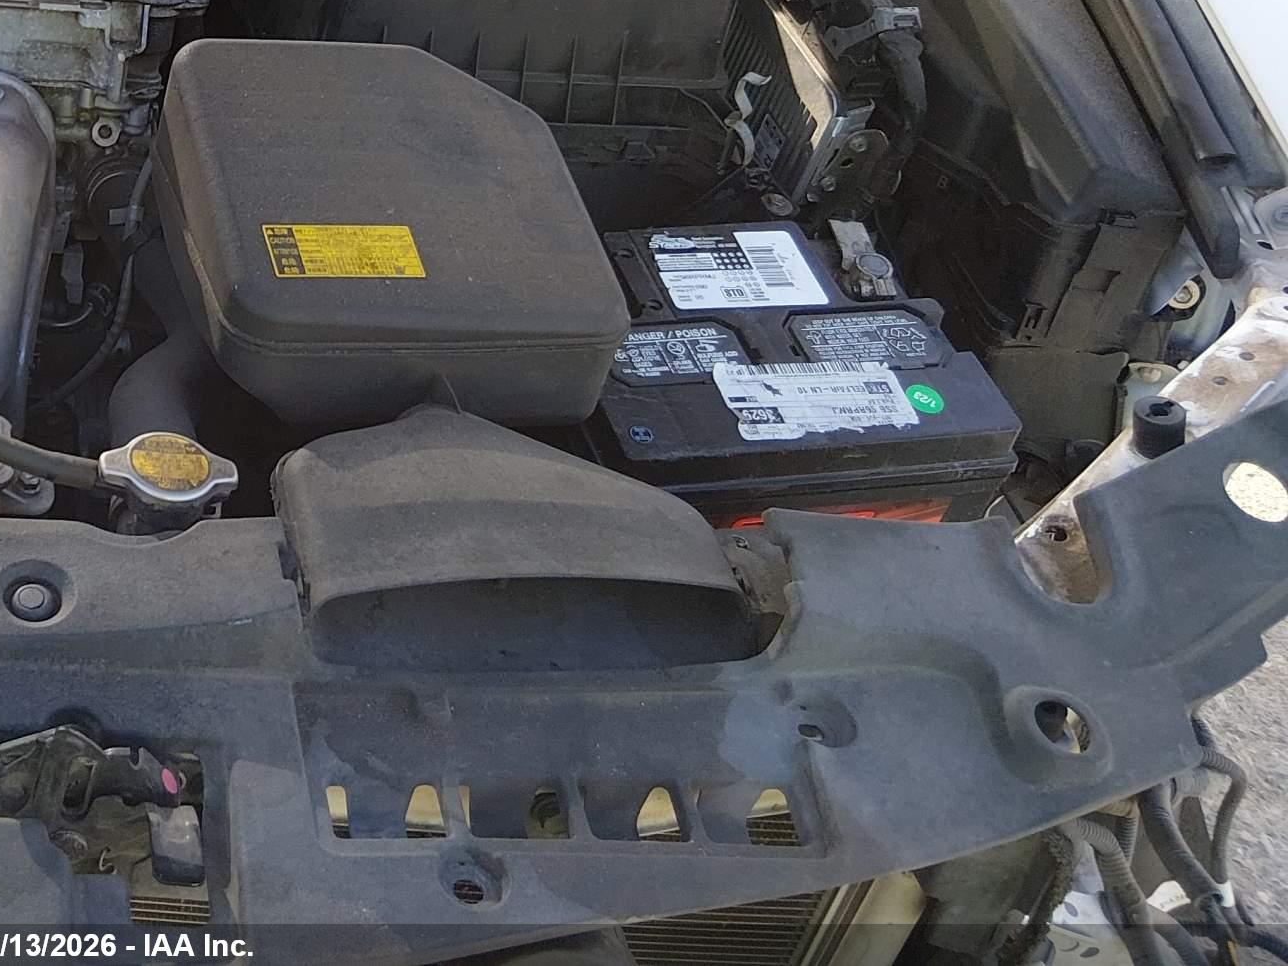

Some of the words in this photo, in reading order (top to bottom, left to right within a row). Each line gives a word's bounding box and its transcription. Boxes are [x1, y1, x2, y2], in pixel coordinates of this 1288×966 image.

[724, 288, 744, 297] STD
[625, 331, 665, 341] ANGER
[674, 328, 717, 338] POISON
